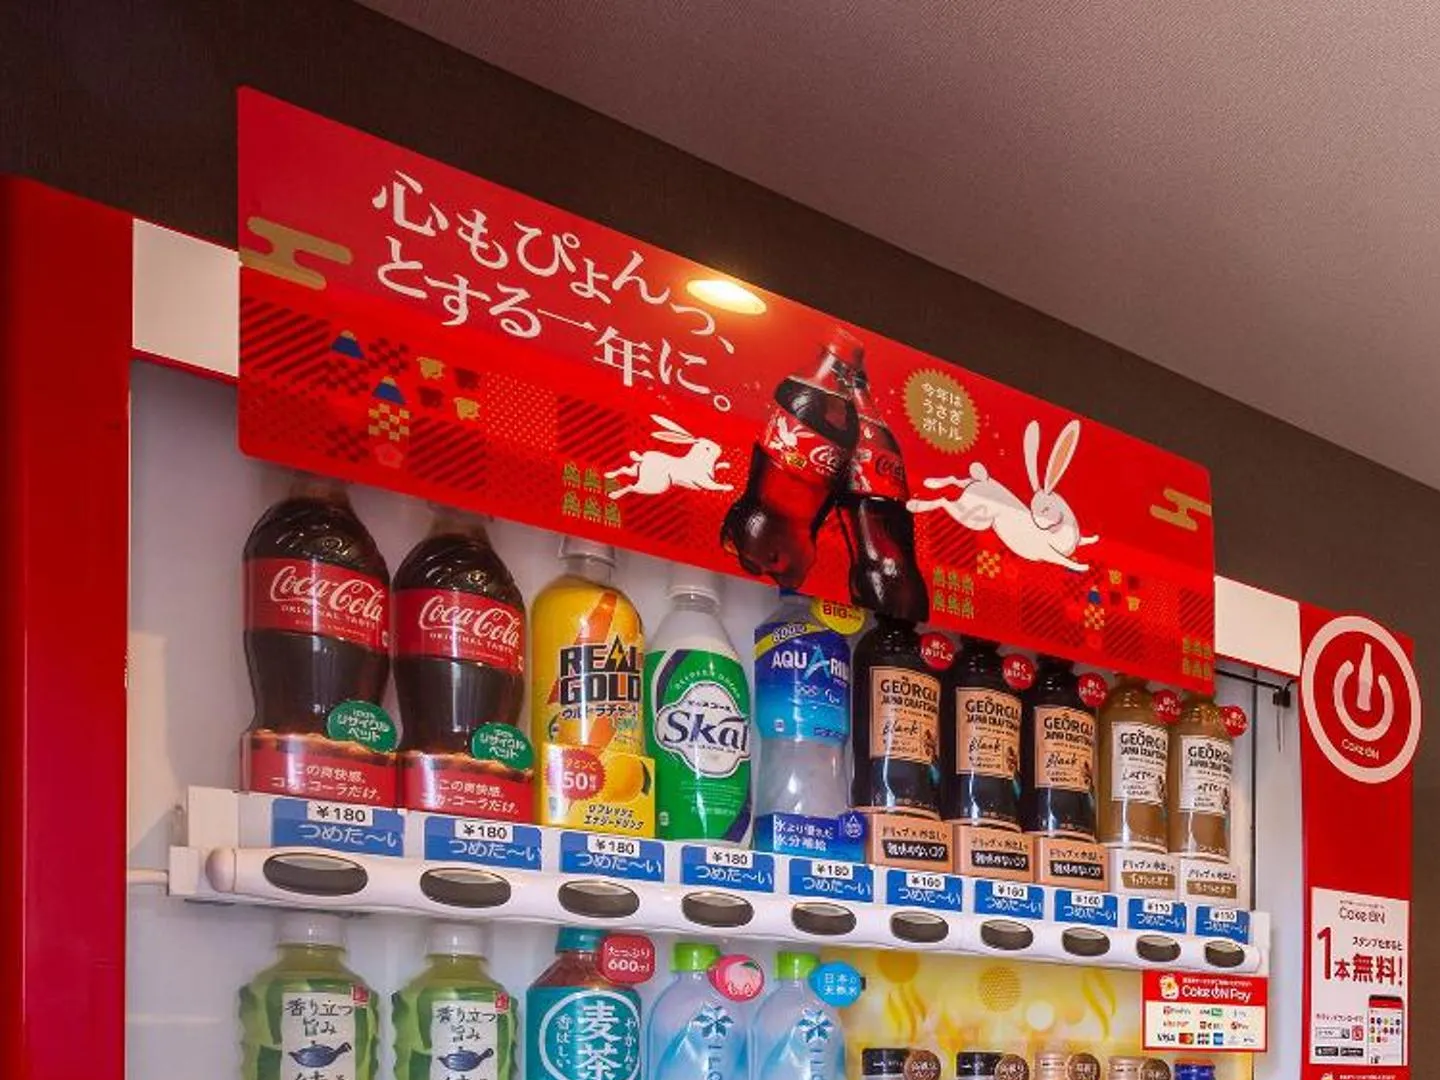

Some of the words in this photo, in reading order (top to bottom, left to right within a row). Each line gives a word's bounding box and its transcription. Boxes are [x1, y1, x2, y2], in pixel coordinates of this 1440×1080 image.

[372, 170, 735, 354] 心もぴょんっ、
[377, 236, 731, 411] とする一年に。
[923, 399, 964, 425] うさぎ
[922, 417, 963, 440] ボトル
[270, 566, 385, 621] Coca-Cola
[419, 596, 521, 648] Coca-Cola
[316, 805, 366, 823] ¥180
[463, 823, 507, 839] ¥180
[596, 838, 635, 855] ¥180
[712, 851, 749, 867] ¥180
[817, 863, 849, 877] ¥180
[824, 973, 858, 984] 日本の
[727, 980, 754, 996] もも
[824, 984, 858, 996] 天然水
[1230, 988, 1252, 1003] Pay
[285, 997, 353, 1018] 香り立つ
[437, 1007, 496, 1025] 香り立つ
[302, 1018, 337, 1038] 旨み
[450, 1025, 482, 1043] 旨み
